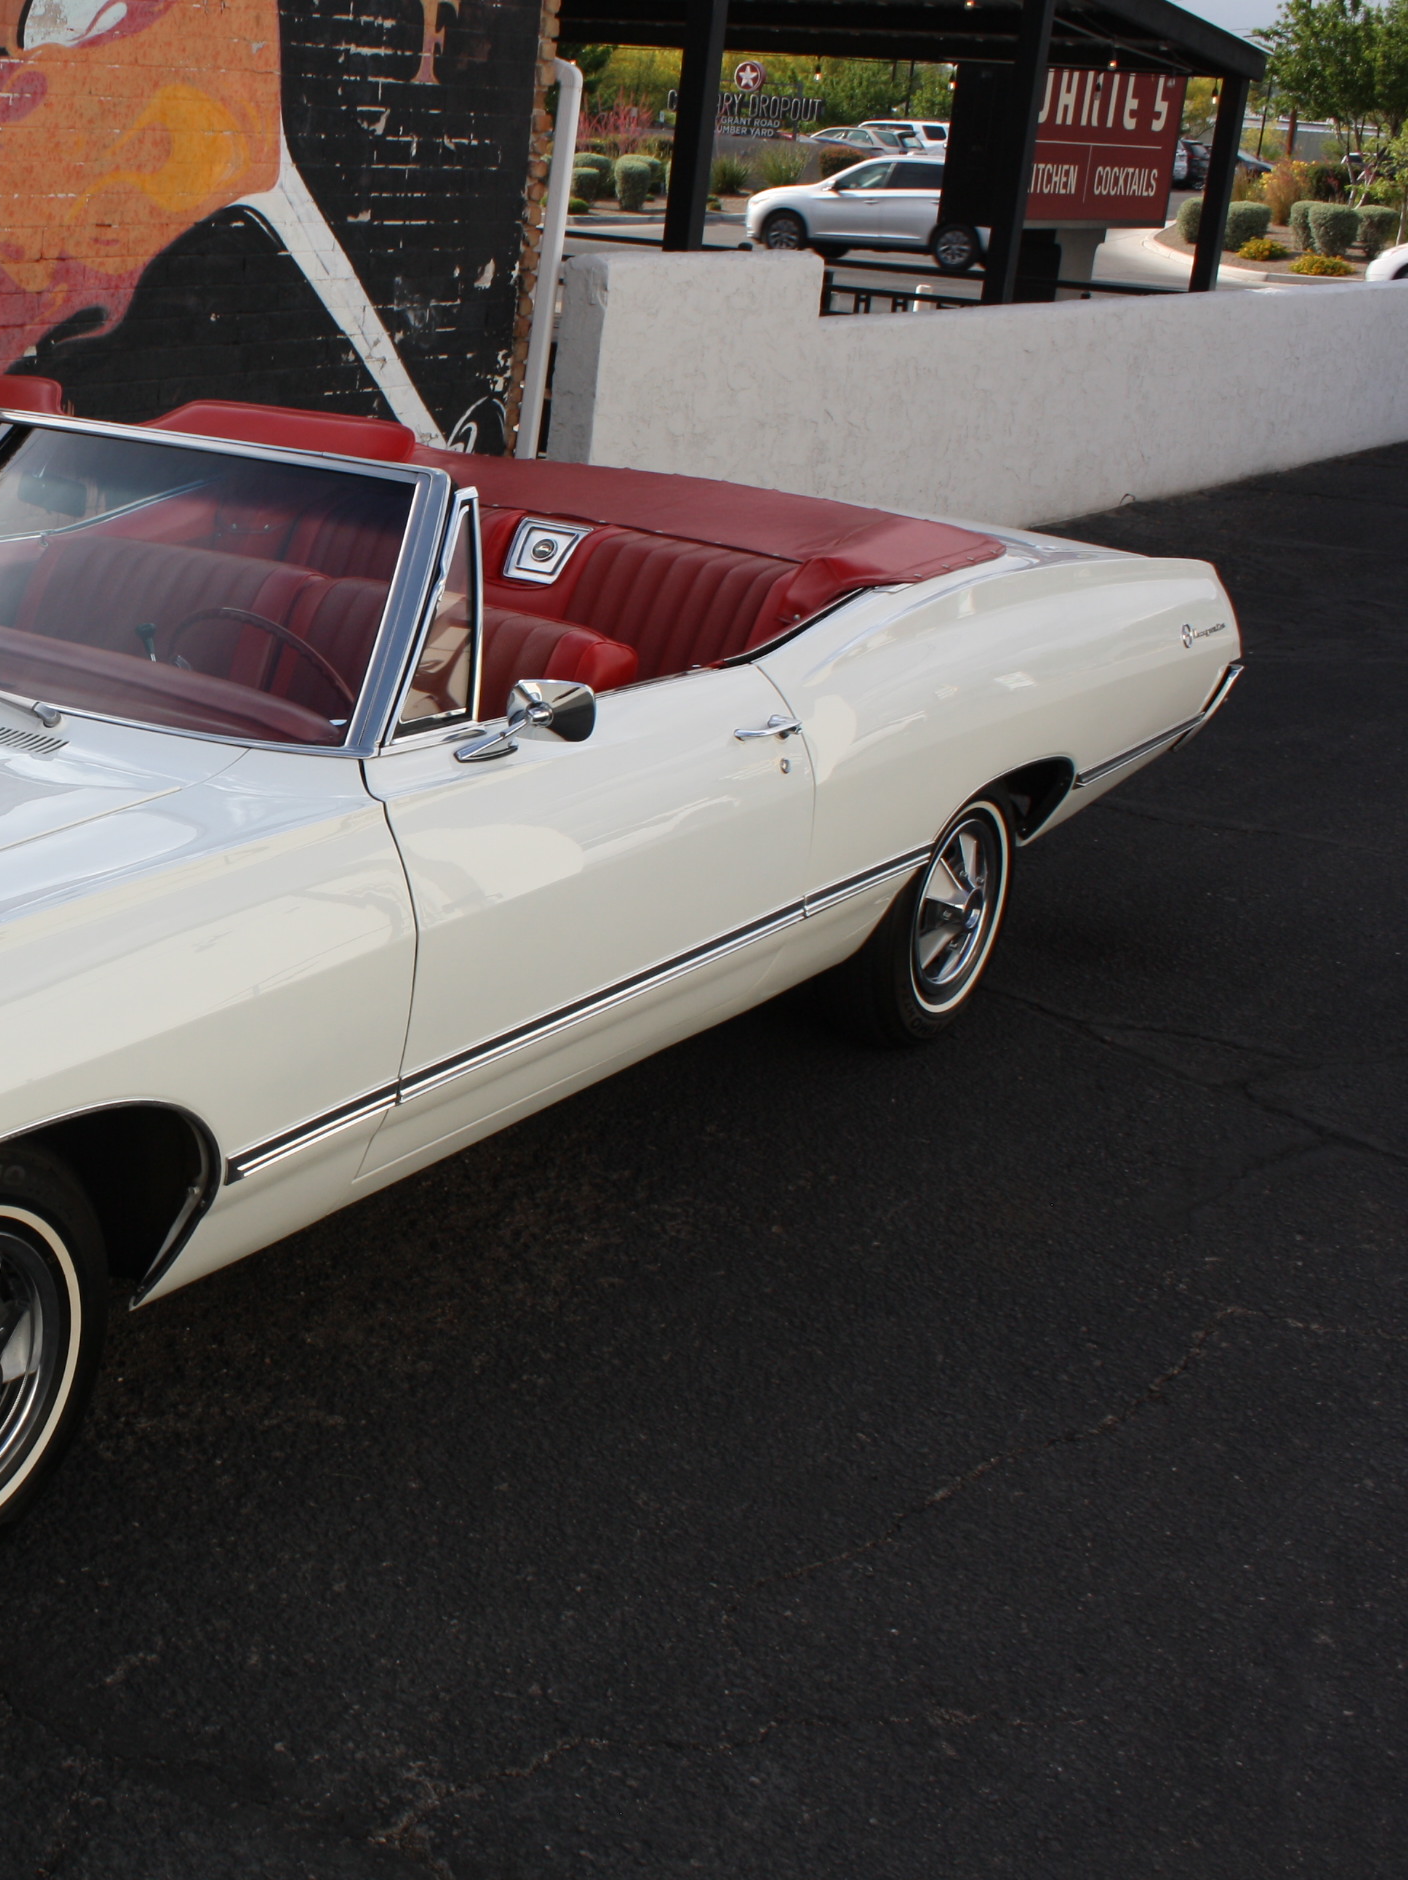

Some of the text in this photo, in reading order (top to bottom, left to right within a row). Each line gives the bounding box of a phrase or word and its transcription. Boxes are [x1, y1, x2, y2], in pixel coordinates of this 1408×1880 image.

[721, 116, 781, 128] GRANT ROAD
[749, 93, 823, 122] DROPOUT
[715, 124, 774, 137] UMBER YARD
[1029, 163, 1079, 195] ITCHEN
[1093, 166, 1158, 197] COCKTAILS
